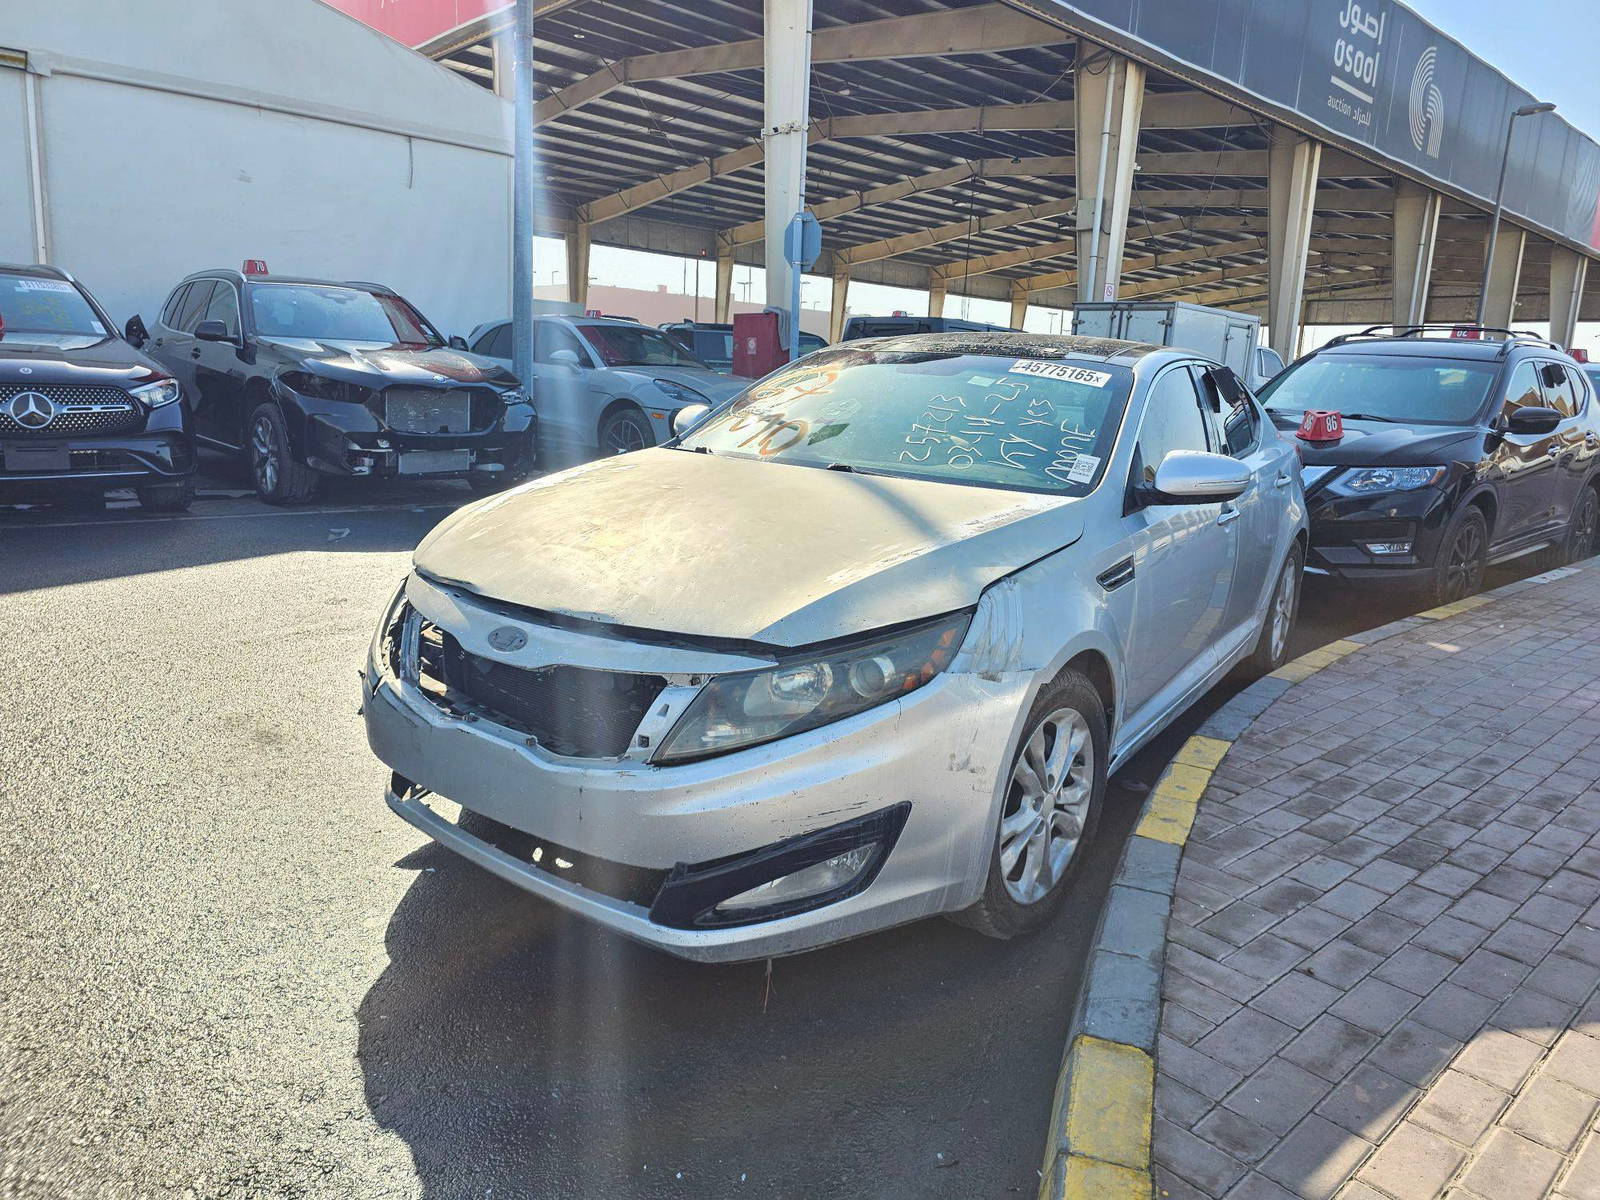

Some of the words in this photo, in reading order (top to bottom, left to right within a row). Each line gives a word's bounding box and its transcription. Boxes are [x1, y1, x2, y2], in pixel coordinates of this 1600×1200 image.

[1334, 38, 1380, 88] osool
[1327, 95, 1352, 117] auction
[1325, 414, 1338, 433] 86
